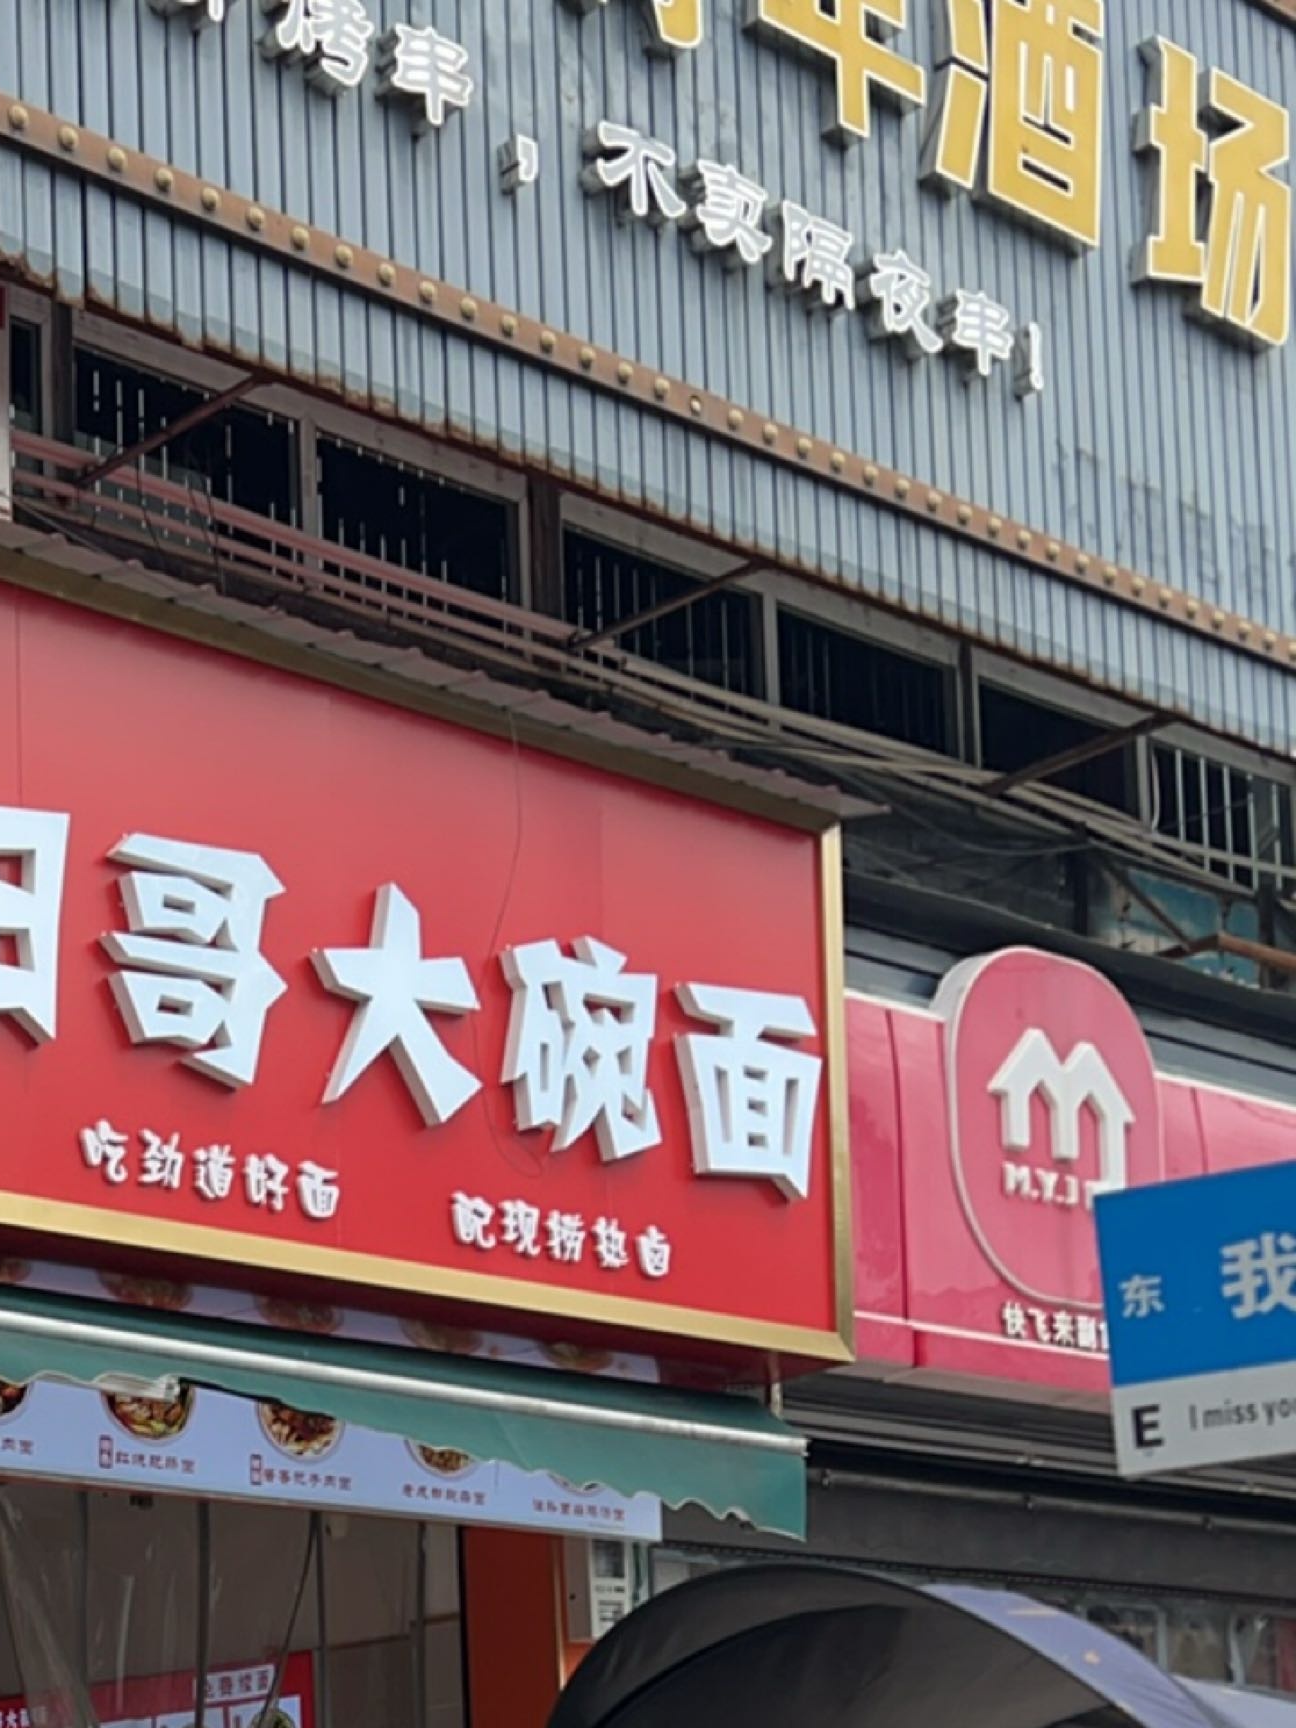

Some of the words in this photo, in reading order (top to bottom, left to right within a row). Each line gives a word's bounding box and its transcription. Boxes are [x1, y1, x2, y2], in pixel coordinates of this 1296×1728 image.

[654, 0, 1290, 346] 酒场
[80, 1119, 341, 1219] 吃劲道好面
[1118, 1274, 1166, 1319] 东
[1219, 1232, 1296, 1320] 我
[1131, 1404, 1165, 1449] E
[1203, 1398, 1259, 1428] miss
[1262, 1396, 1296, 1427] yo
